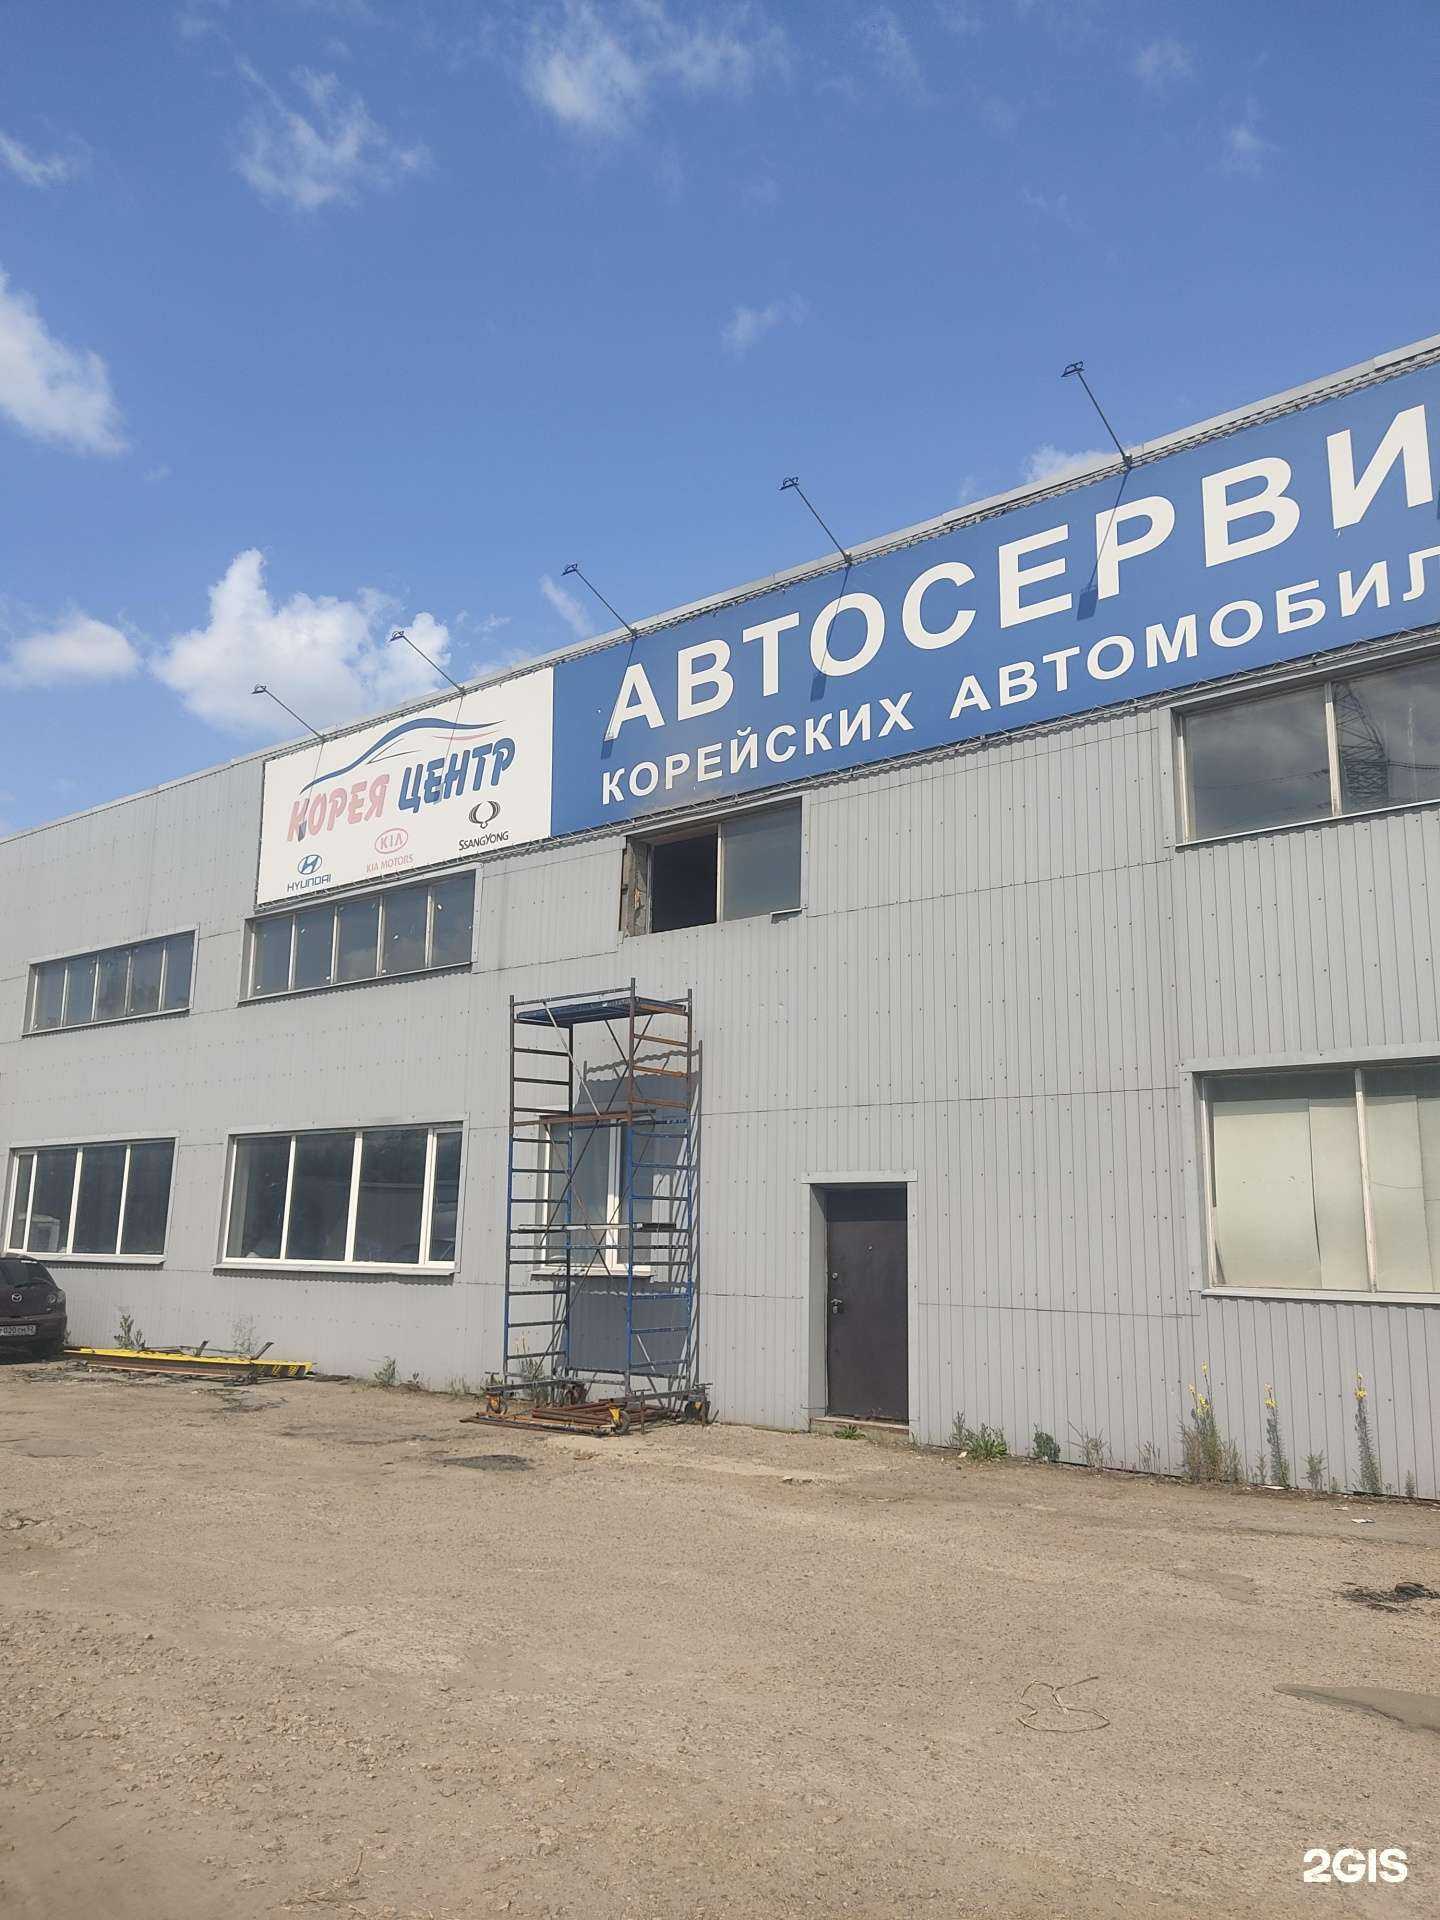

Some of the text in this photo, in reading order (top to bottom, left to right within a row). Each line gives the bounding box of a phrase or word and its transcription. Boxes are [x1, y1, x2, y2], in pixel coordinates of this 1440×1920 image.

[603, 404, 1435, 743] АВТОСЕРВИ
[602, 691, 914, 805] КОРЕЙСКИХ
[287, 737, 516, 842] КОРЕЯ ЦЕНТР
[366, 854, 414, 873] KIA MOTORS
[379, 832, 403, 850] KIA
[286, 873, 332, 893] HYUNDAI
